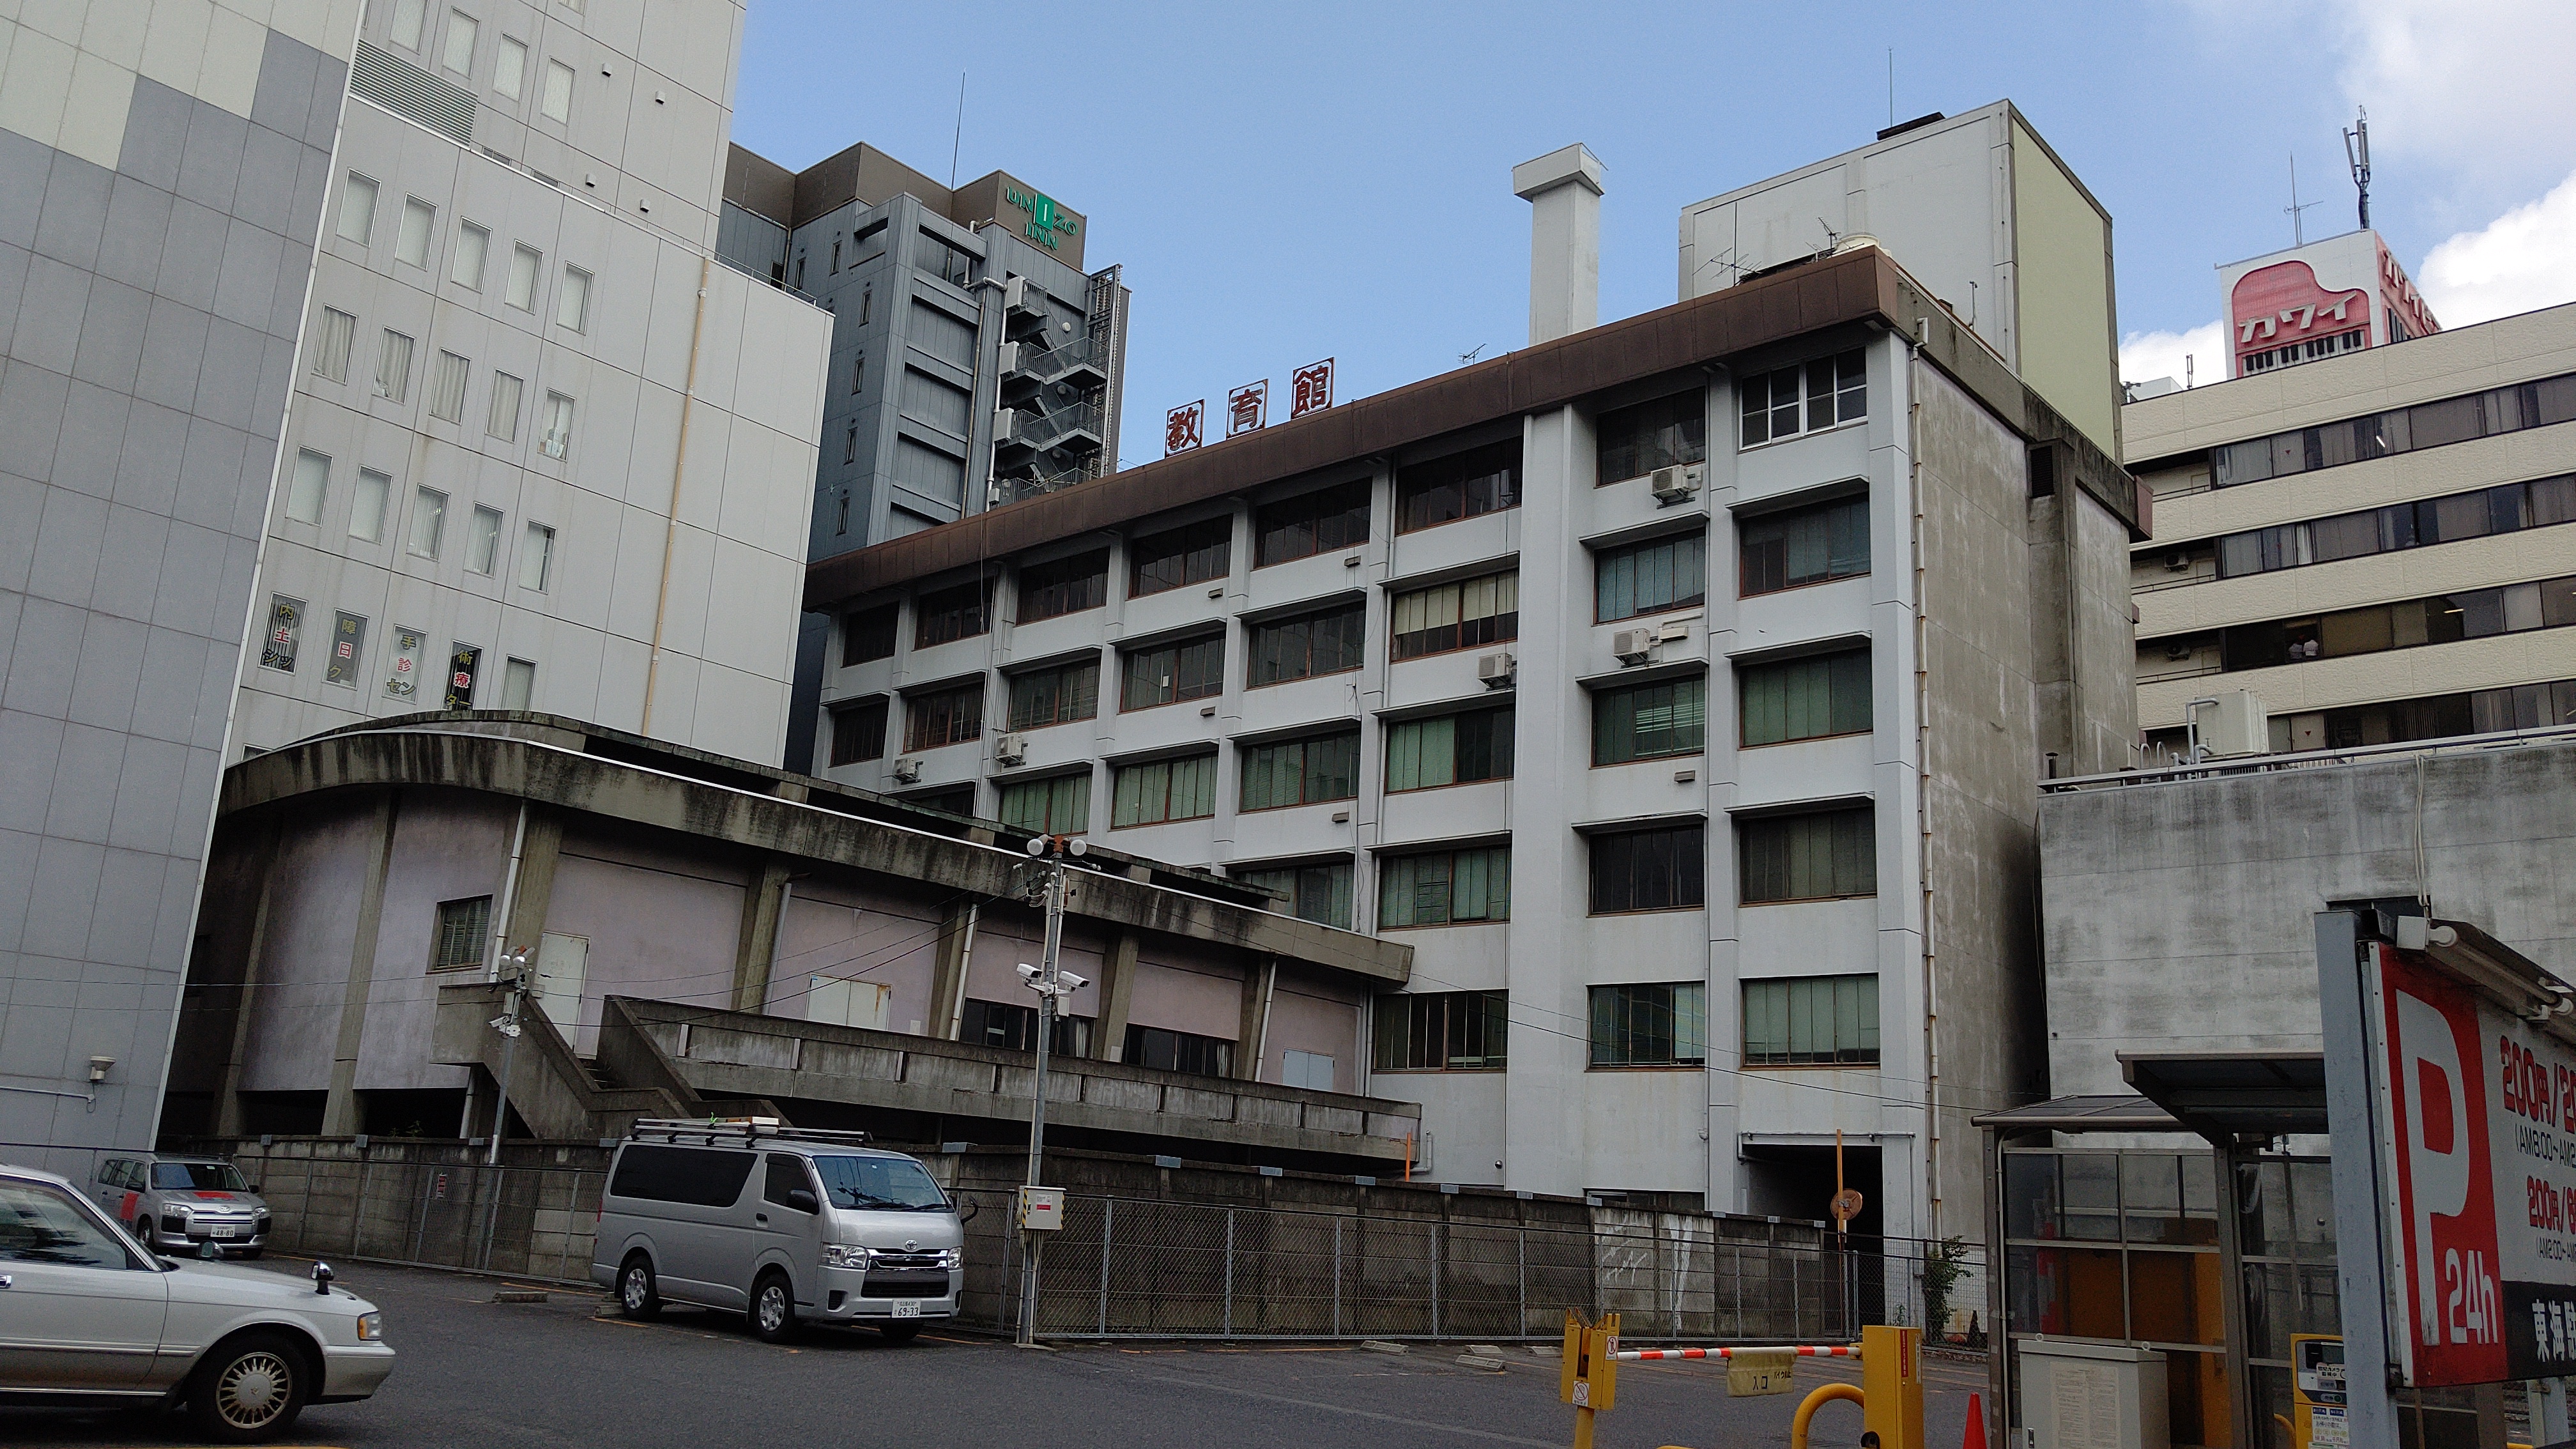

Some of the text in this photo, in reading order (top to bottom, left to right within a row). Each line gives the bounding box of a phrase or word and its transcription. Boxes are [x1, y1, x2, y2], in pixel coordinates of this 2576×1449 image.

[1007, 187, 1078, 236] UNIZO
[1025, 222, 1059, 250] INN
[2239, 291, 2357, 343] カワイ
[1167, 365, 1329, 451] 教育館
[2396, 988, 2469, 1346] P
[898, 1307, 919, 1316] 69-33
[2446, 1248, 2498, 1344] 24h
[1752, 1376, 1768, 1390] 入口
